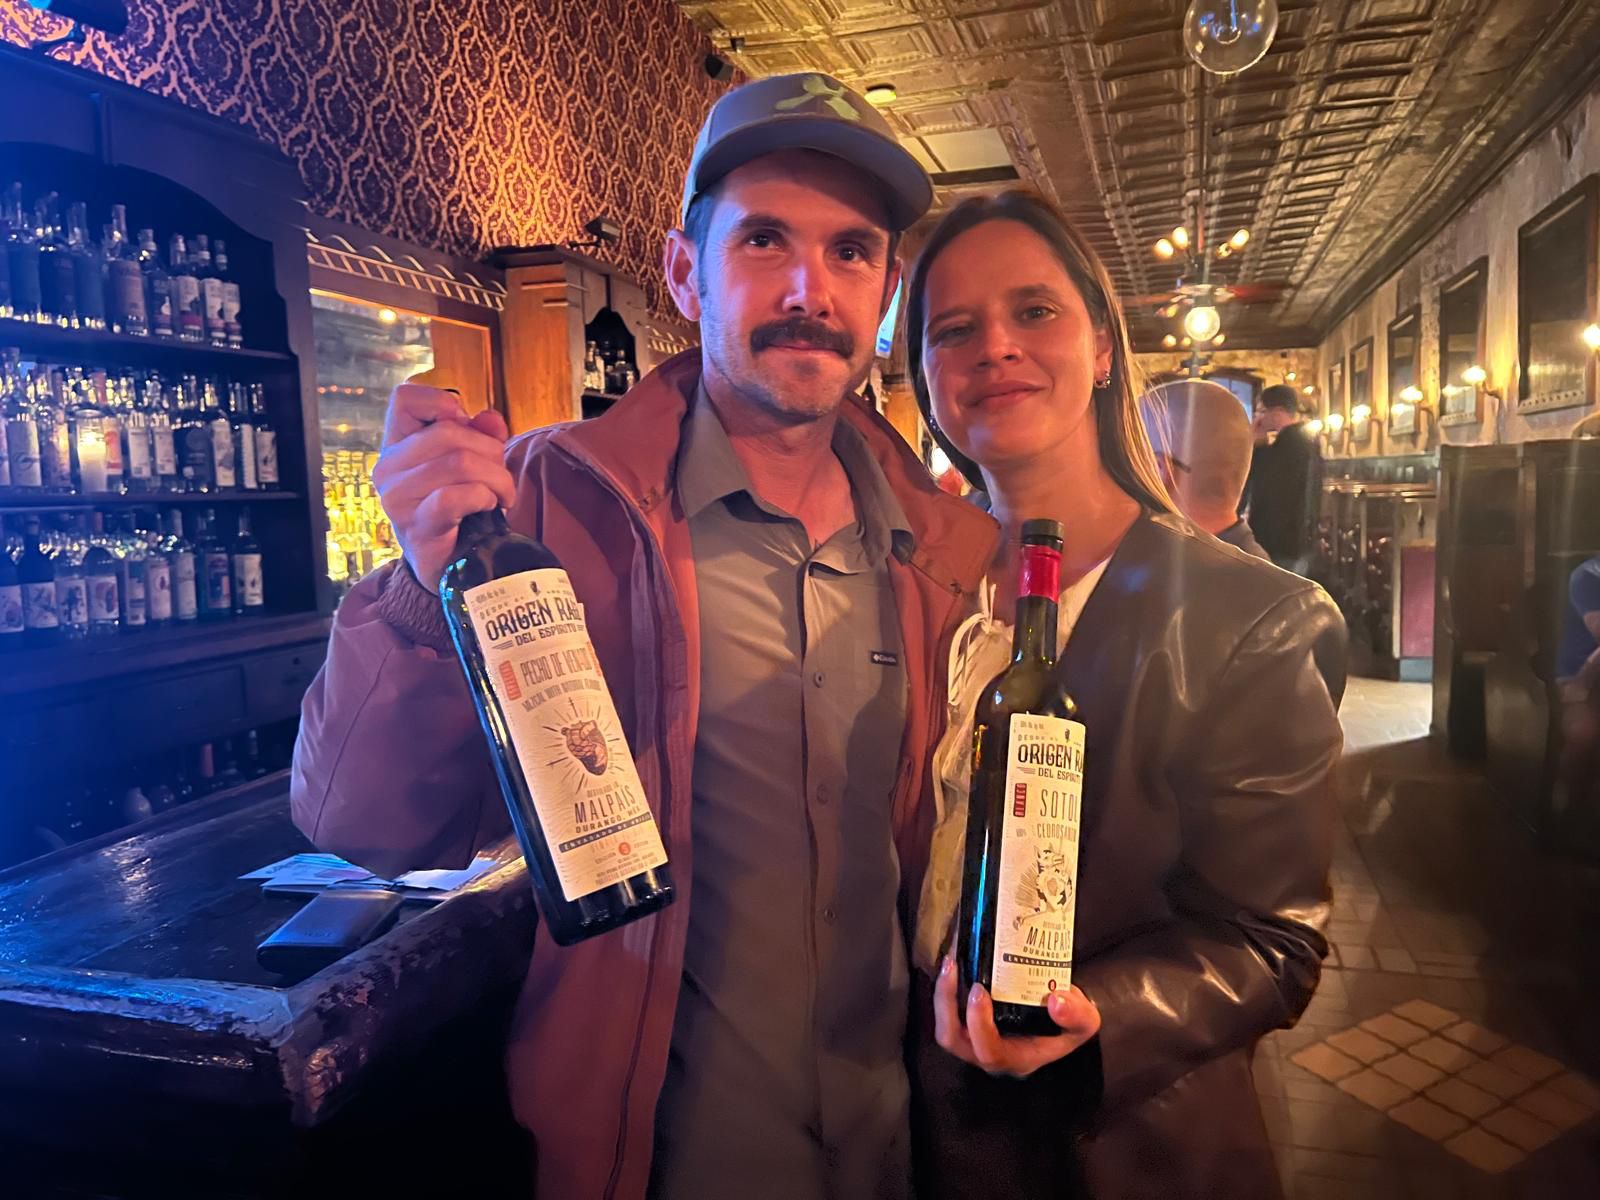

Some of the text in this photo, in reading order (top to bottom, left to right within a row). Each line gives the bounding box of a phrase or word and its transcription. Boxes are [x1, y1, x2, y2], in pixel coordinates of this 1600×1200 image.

[485, 598, 555, 642] ORIGEN
[515, 631, 536, 646] DEL
[520, 655, 553, 687] PECHO
[550, 652, 566, 677] DE
[1017, 743, 1072, 770] ORIGEN
[1038, 767, 1054, 779] DEL
